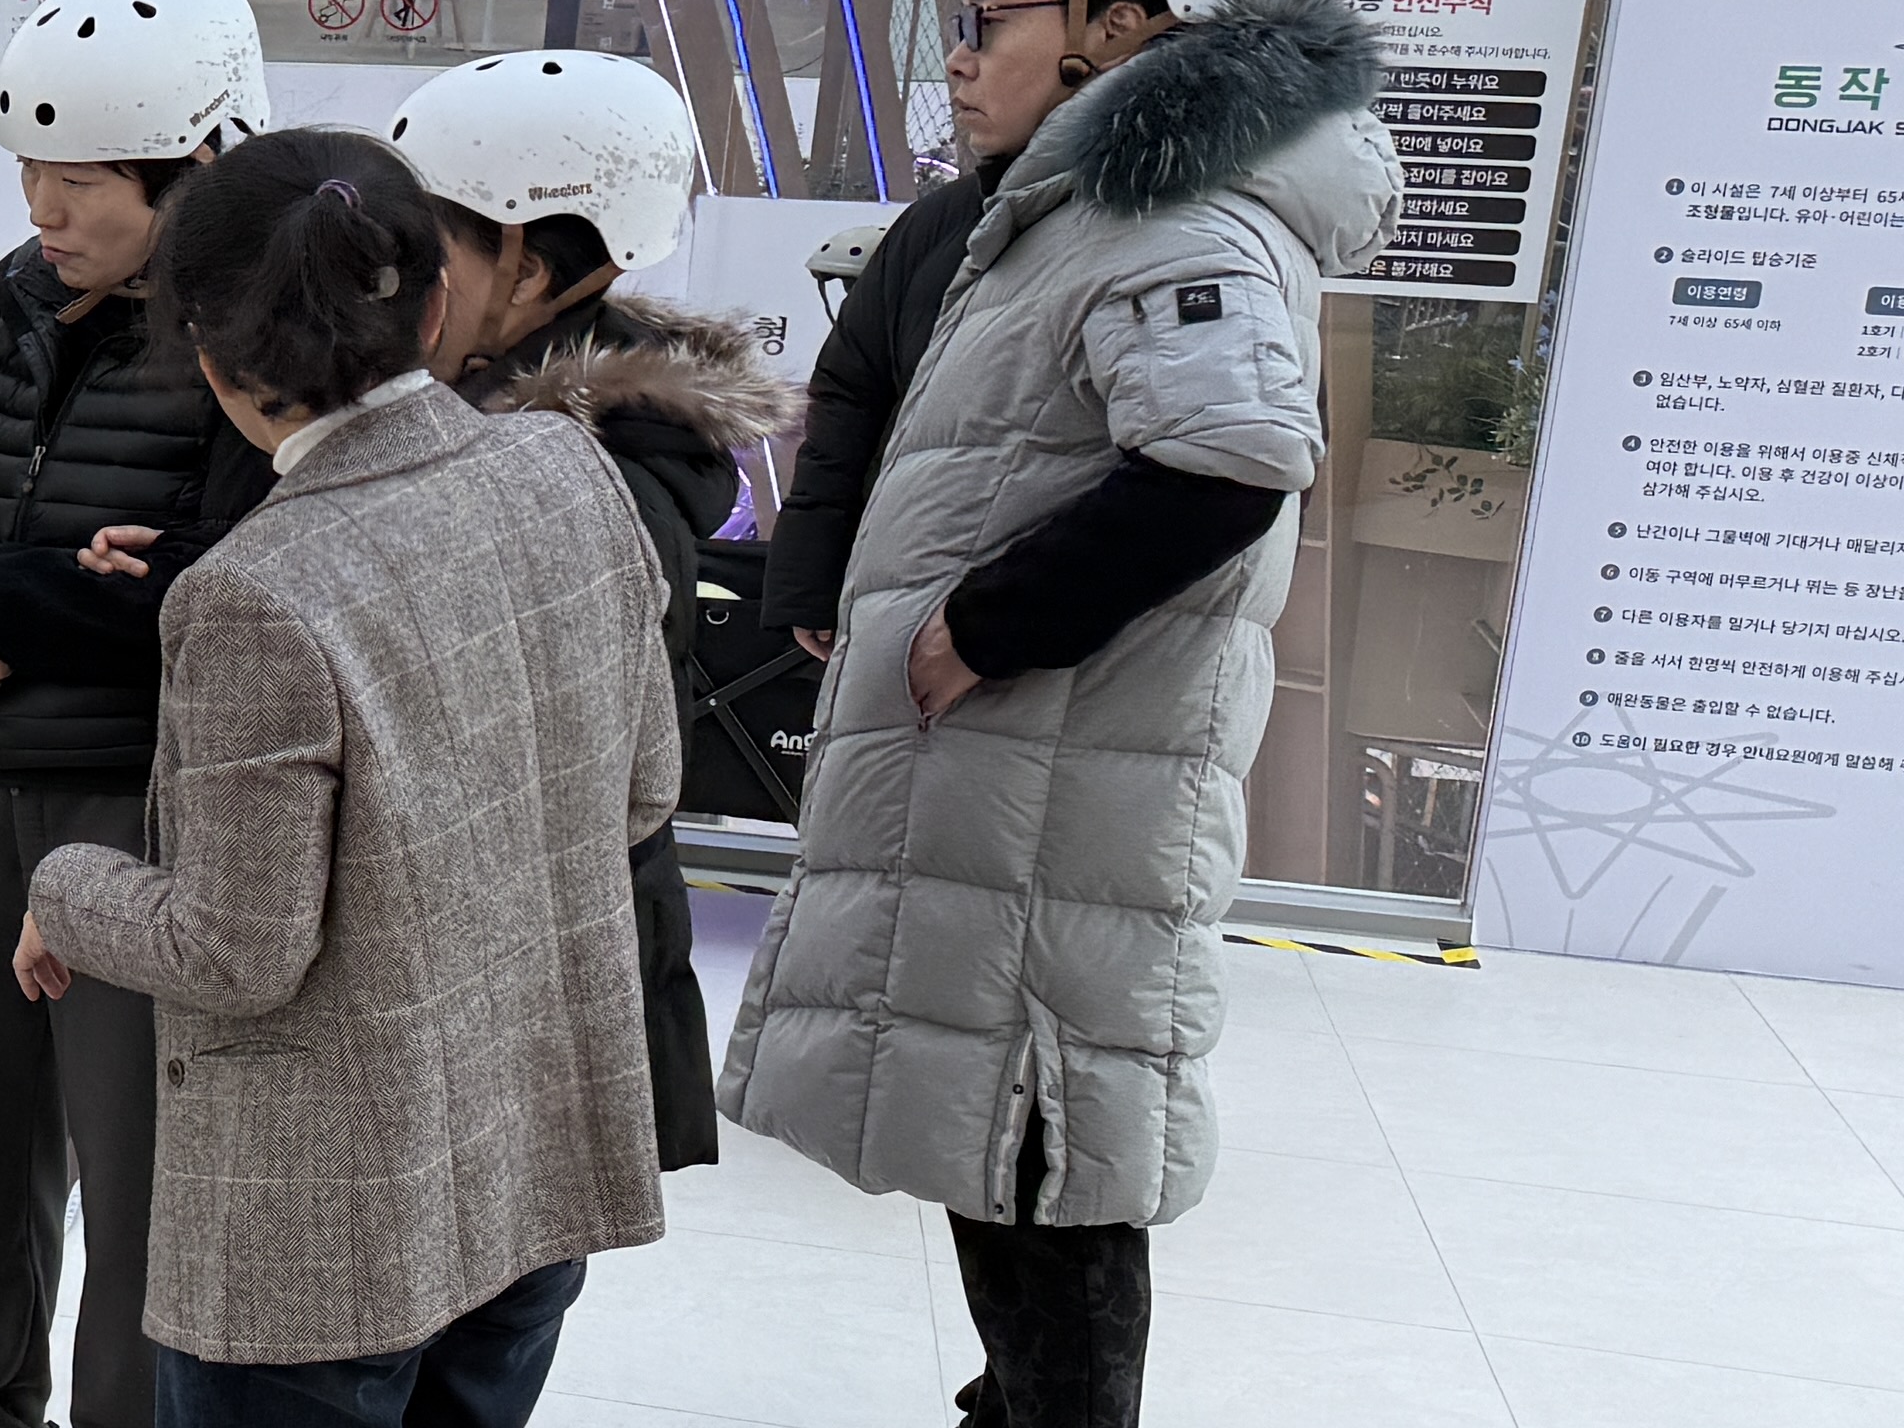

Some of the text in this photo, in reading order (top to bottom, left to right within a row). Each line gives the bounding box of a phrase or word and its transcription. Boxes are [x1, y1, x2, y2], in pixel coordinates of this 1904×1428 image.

[1465, 46, 1499, 58] 주시기
[1400, 72, 1447, 89] 반듯이
[1451, 74, 1500, 91] 누워요
[1774, 65, 1890, 111] 동작
[1407, 105, 1487, 122] 들어주세요
[1767, 116, 1885, 136] DONGJAK
[1691, 181, 1706, 197] 이
[1712, 182, 1762, 200] 시설은
[1769, 185, 1797, 201] 7세
[1802, 185, 1869, 204] 이상부터
[1427, 231, 1475, 247] 마세요
[1680, 248, 1746, 266] 슬라이드
[1752, 251, 1817, 269] 탑승기준
[1686, 285, 1748, 301] 이용연령
[1668, 315, 1782, 332] 7세 이상 65세 이하
[1861, 325, 1896, 339] 1호기
[1856, 345, 1892, 359] 2호기
[1659, 372, 1713, 391] 임산부,
[1716, 375, 1771, 394] 노약자,
[1776, 378, 1825, 396] 심혈관
[1831, 381, 1886, 401] 질환자,
[1655, 394, 1726, 412] 없습니다.
[1649, 437, 1698, 455] 안전한
[1703, 441, 1752, 459] 이용을
[1757, 444, 1806, 462] 위해서
[1811, 447, 1861, 465] 이용중
[1645, 459, 1679, 475] 여야
[1683, 461, 1736, 479] 합니다.
[1741, 465, 1774, 482] 이용
[1778, 467, 1795, 483] 후
[1801, 469, 1850, 487] 건강이
[1642, 481, 1766, 503] 삼가해 주십시오.
[1636, 523, 1701, 543] 난간이나
[1704, 529, 1771, 548] 그물벽에
[1775, 533, 1841, 552] 기대거나
[1628, 567, 1660, 584] 이동
[1665, 569, 1714, 587] 구역에
[1718, 573, 1800, 593] 머무르거나
[1805, 578, 1838, 596] 뛰는
[1843, 581, 1861, 598] 등
[1621, 608, 1653, 625] 다른
[1658, 611, 1723, 631] 이용자를
[1728, 616, 1776, 635] 밀거나
[1781, 619, 1831, 639] 당기지
[1613, 650, 1646, 667] 줄을
[1650, 653, 1683, 670] 서서
[1688, 656, 1736, 674] 한명씩
[1741, 660, 1806, 679] 안전하게
[1811, 665, 1860, 684] 이용해
[1606, 691, 1687, 712] 애완동물은
[1691, 698, 1740, 716] 출입할
[1745, 703, 1761, 718] 수
[1766, 704, 1836, 725] 없습니다.
[1599, 733, 1648, 752] 도움이
[1652, 737, 1701, 756] 필요한
[1705, 741, 1738, 759] 경우
[1742, 745, 1840, 769] 안내요원에게
